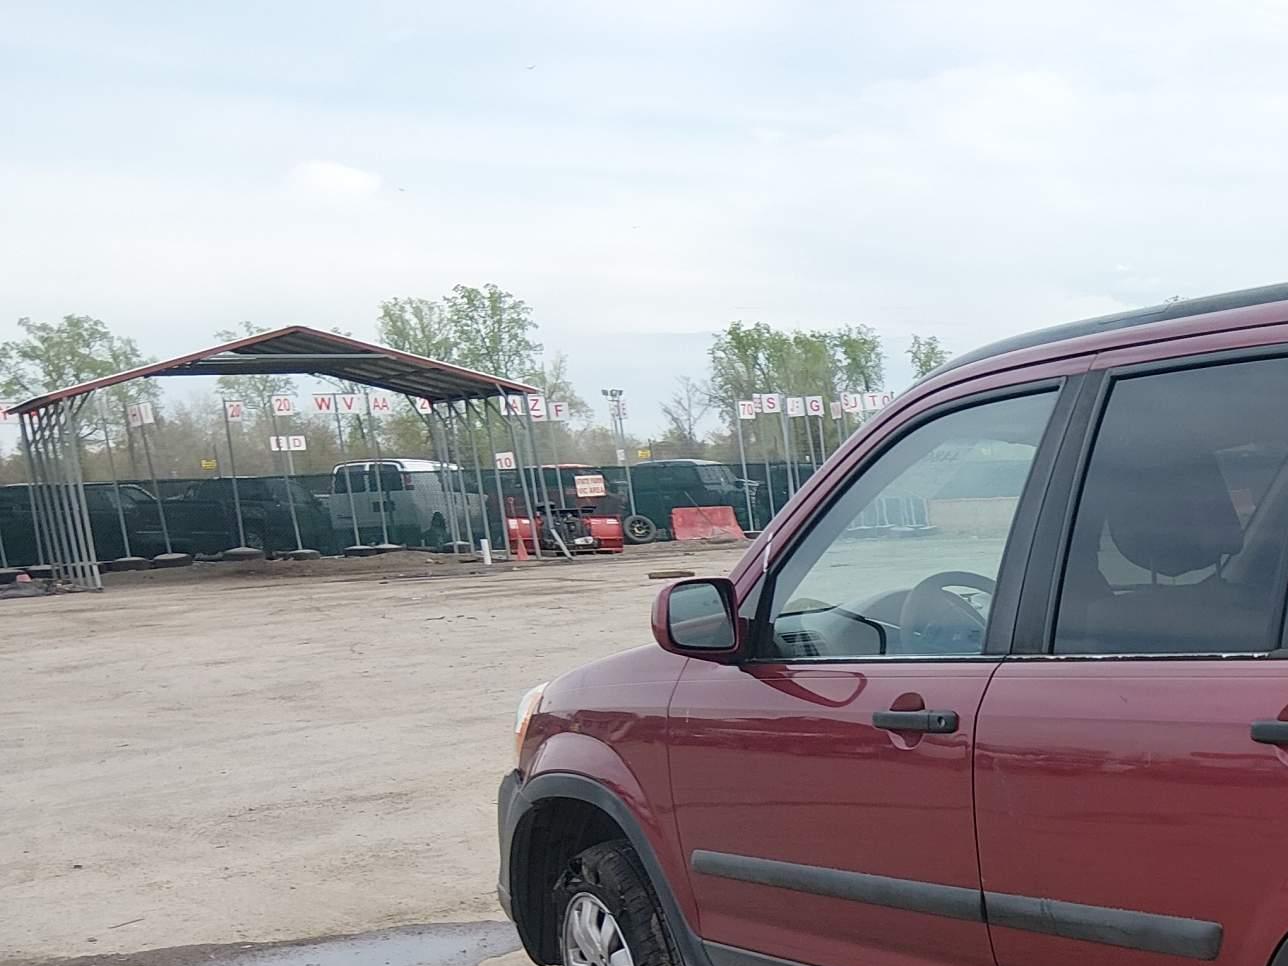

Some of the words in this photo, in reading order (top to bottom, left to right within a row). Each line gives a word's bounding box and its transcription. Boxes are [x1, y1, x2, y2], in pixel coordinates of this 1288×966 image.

[275, 399, 290, 411] 20
[314, 397, 331, 410] W
[342, 397, 354, 410] V
[373, 398, 390, 410] AA
[529, 399, 541, 411] Z
[740, 403, 753, 415] 70
[766, 397, 776, 409] S
[810, 400, 820, 411] G
[229, 404, 241, 417] 20
[554, 404, 563, 417] F
[497, 457, 513, 468] 10
